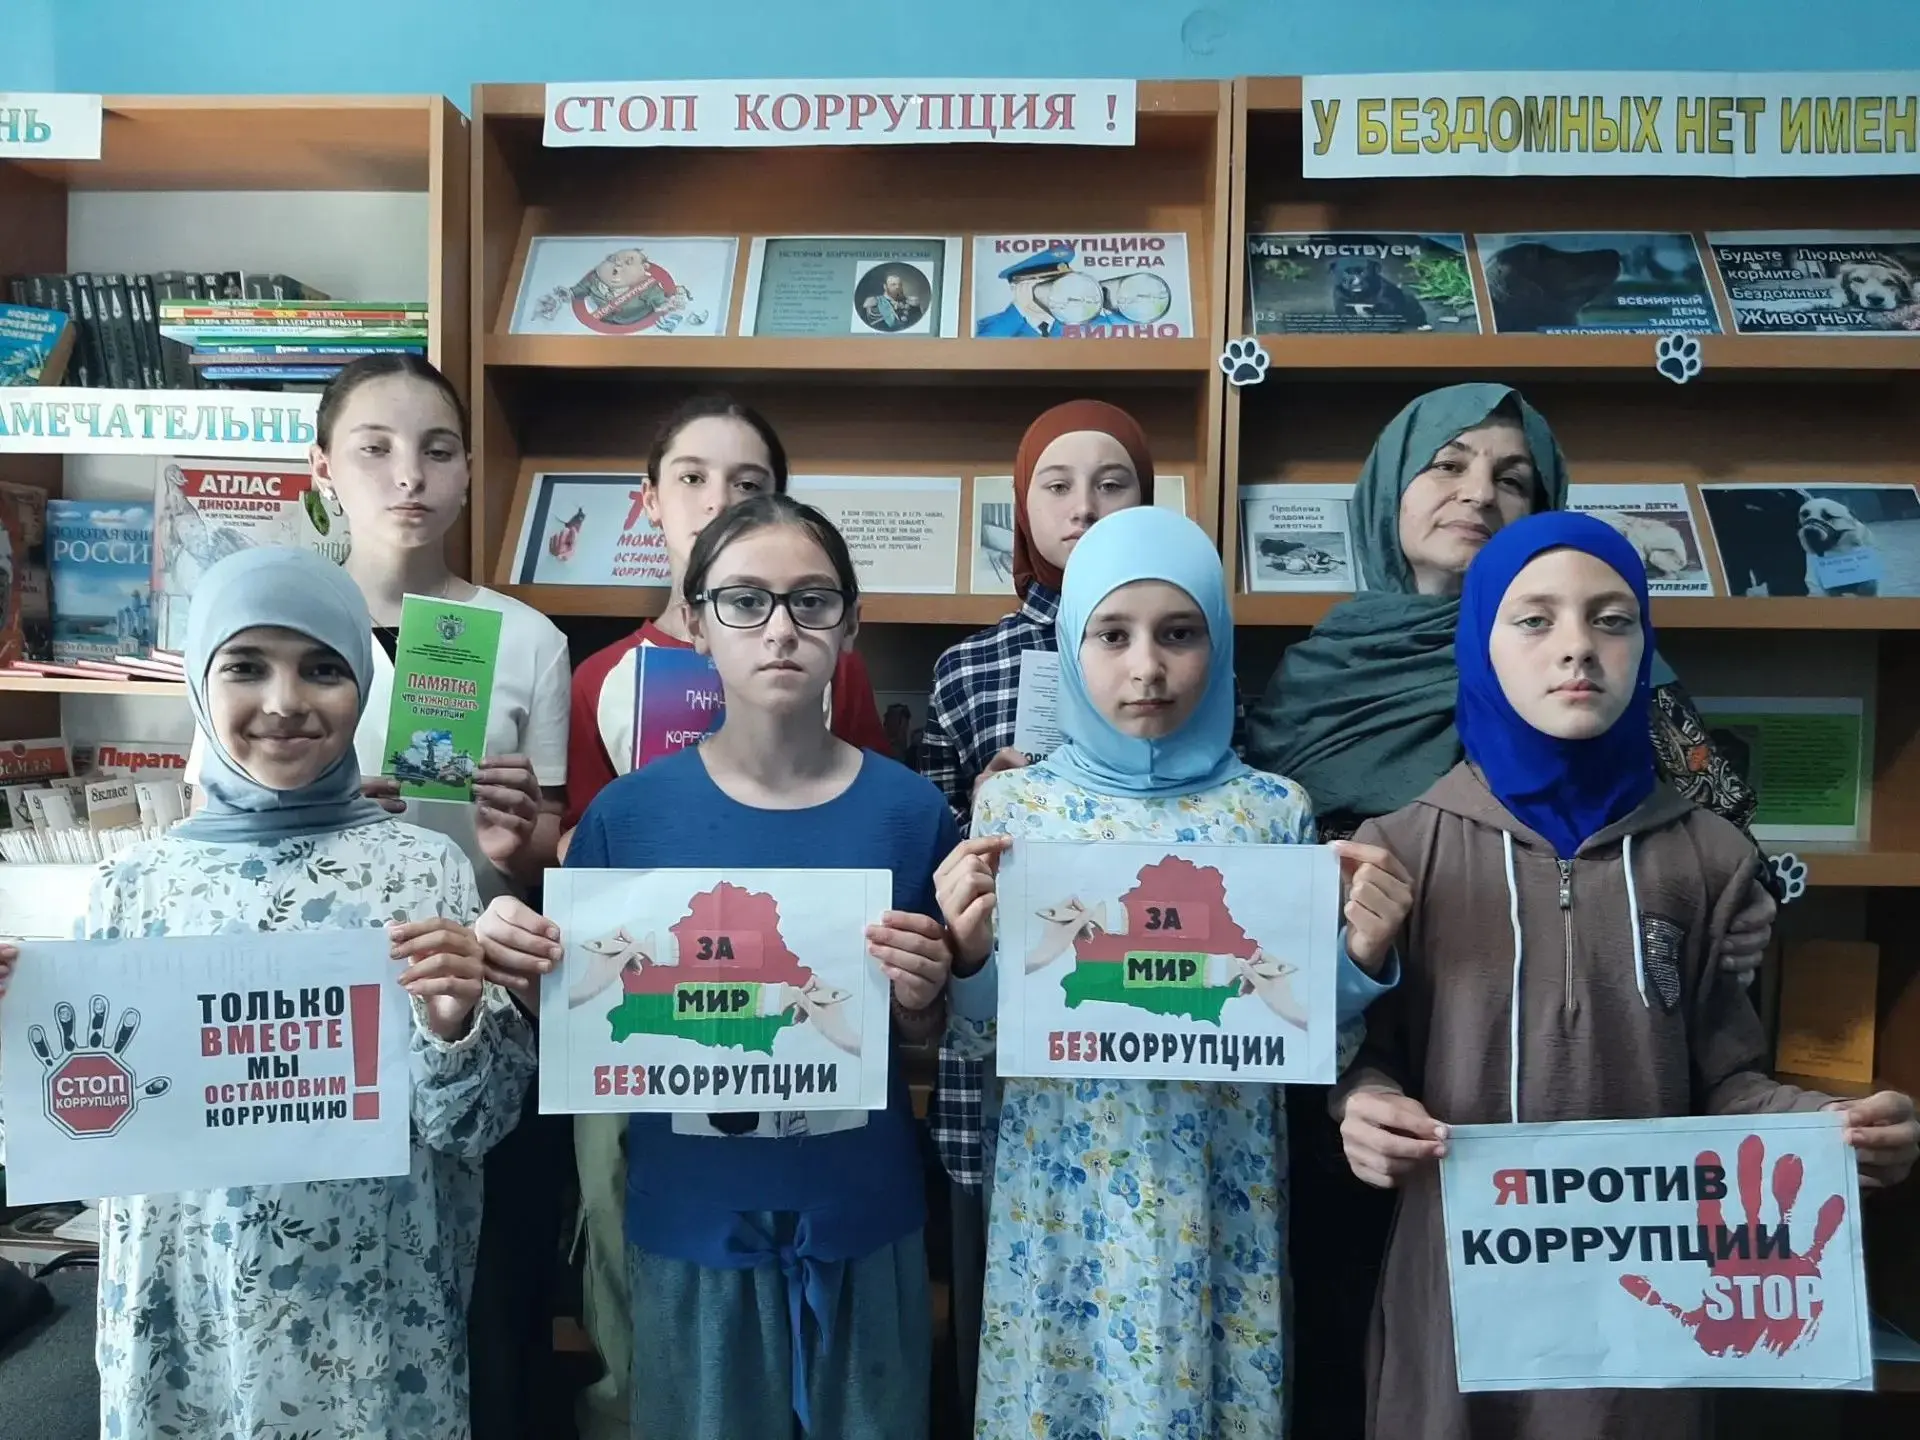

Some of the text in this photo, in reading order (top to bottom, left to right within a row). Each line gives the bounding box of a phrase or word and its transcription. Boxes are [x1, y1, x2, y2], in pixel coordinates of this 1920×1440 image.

[554, 93, 1118, 139] СТОП КОРРУПЦИЯ !
[1311, 96, 1918, 156] У БЕЗДОМНЫХ НЕТ ИМЕН
[995, 237, 1166, 254] КОРРУПЦИЮ
[1250, 241, 1422, 259] Мы чувствуем
[1720, 248, 1877, 263] Будьте Людьми
[1083, 255, 1166, 268] ВСЕГДА
[1727, 269, 1802, 283] кормите
[1617, 295, 1703, 306] ВСЕМИРНЫЙ
[1731, 286, 1830, 300] Бездомных
[1649, 318, 1710, 327] ЗАЩИТЫ
[1671, 307, 1707, 317] ДЕНЬ
[200, 474, 282, 496] АТЛАС
[198, 499, 282, 512] ДИНОЗАВРОВ
[1271, 504, 1321, 513] Проблема
[1645, 502, 1679, 510] ДЕТИ
[1268, 513, 1325, 521] бездомных
[53, 540, 152, 565] РОССИ
[1648, 583, 1709, 591] УПЛЕНИЕ
[407, 672, 478, 696] ПАМЯТКА
[402, 692, 479, 710] ЧТО НУЖНО ЗНАТЬ
[686, 689, 725, 711] ПАНА
[420, 707, 465, 719] КОРРУПЦИИ
[1144, 907, 1182, 931] ЗА
[696, 936, 735, 961] ЗА
[1127, 957, 1198, 982] МИР
[197, 985, 345, 1024] ТОЛЬКО
[677, 989, 751, 1012] МИР
[200, 1018, 343, 1057] ВМЕСТЕ
[247, 1054, 299, 1081] МЫ
[56, 1074, 126, 1097] СТОП
[204, 1076, 347, 1105] ОСТАНОВИМ
[55, 1094, 128, 1109] КОРРУПЦИЯ
[206, 1099, 348, 1128] КОРРУПЦИЮ
[1462, 1223, 1792, 1267] КОРРУПЦИИ
[1705, 1274, 1824, 1321] STOP
